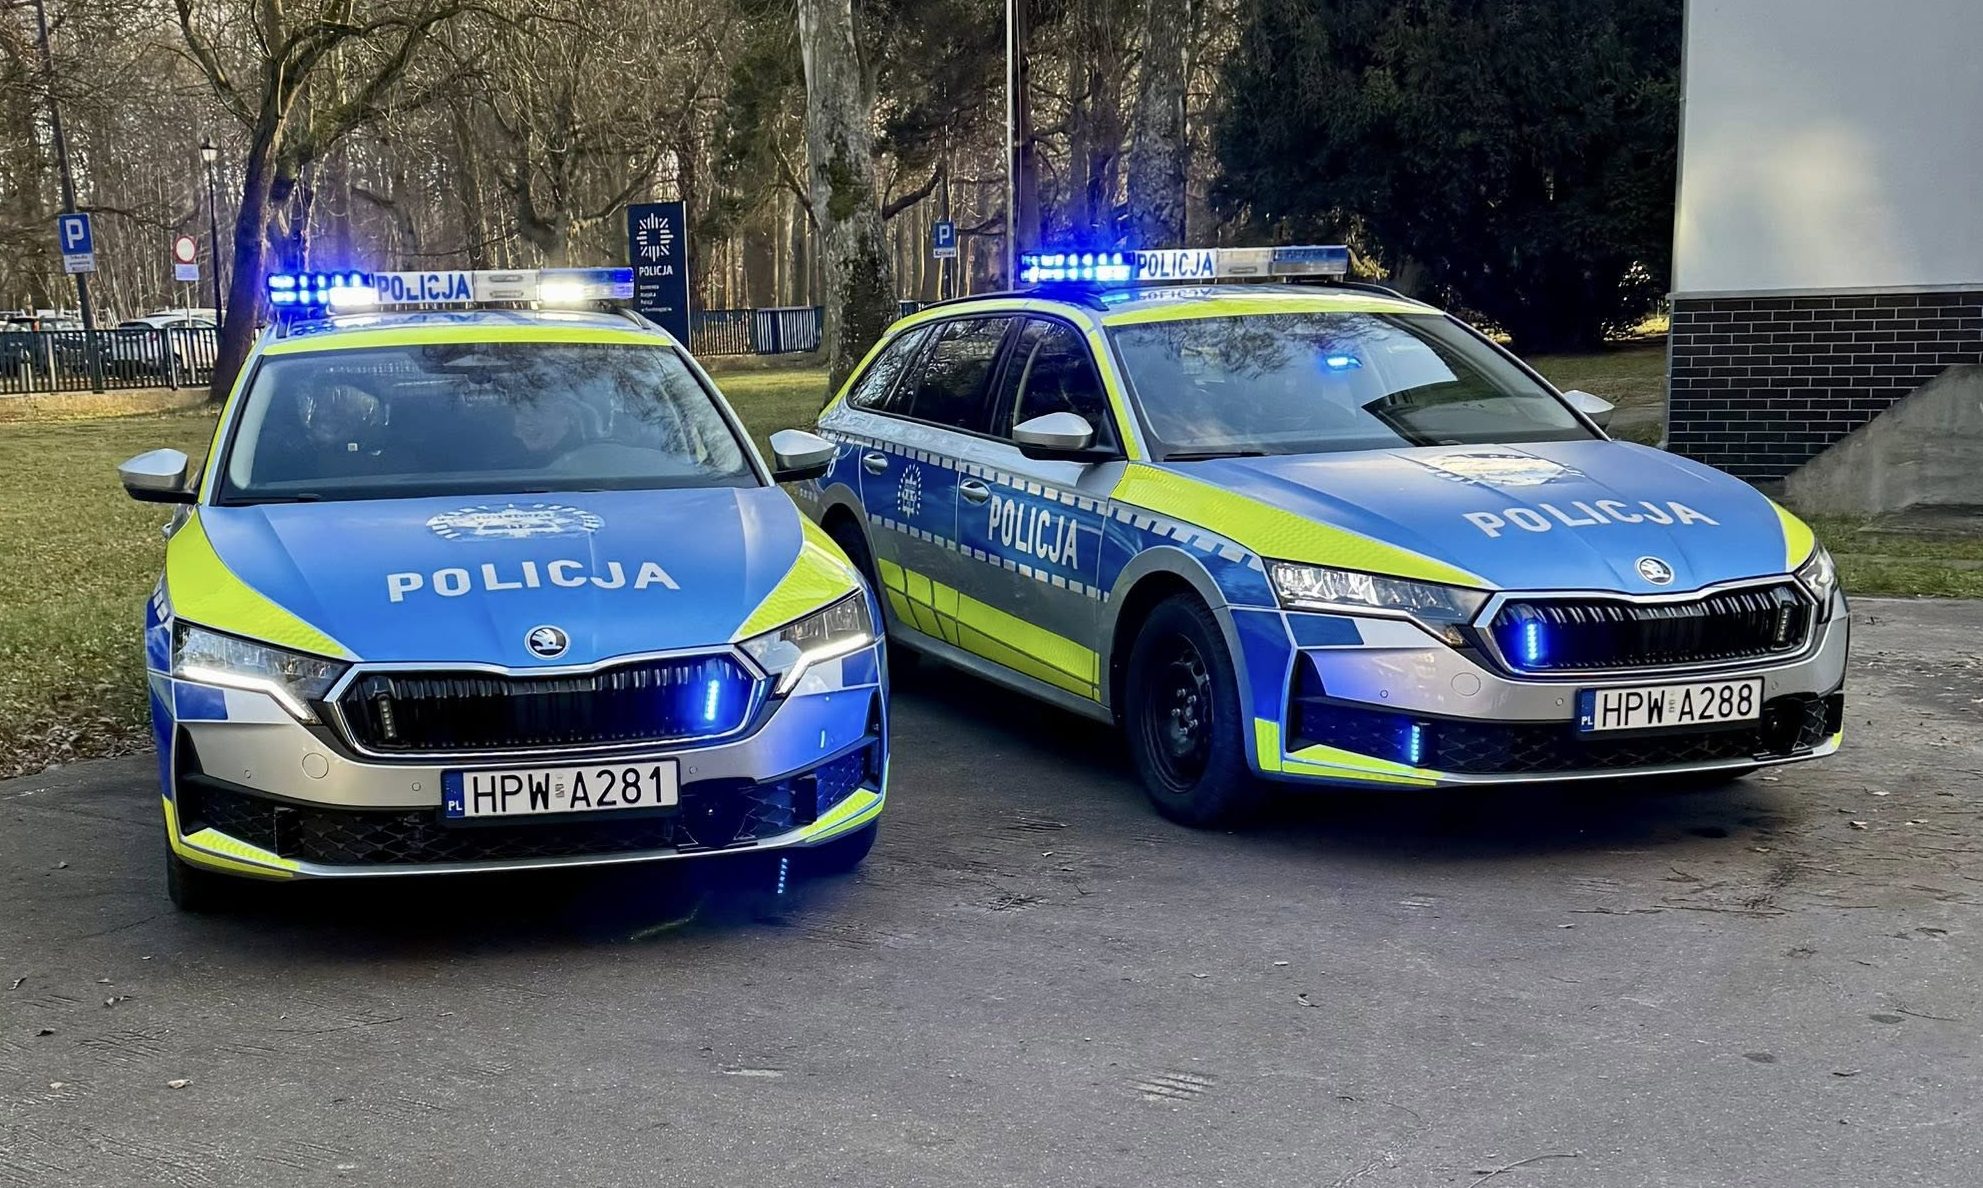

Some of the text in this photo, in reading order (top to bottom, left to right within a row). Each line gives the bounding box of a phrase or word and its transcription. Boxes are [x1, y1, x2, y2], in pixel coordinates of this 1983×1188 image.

[65, 218, 84, 249] P
[939, 225, 950, 245] P
[639, 265, 674, 276] POLICJA
[1135, 252, 1214, 278] POLICJA
[376, 273, 471, 302] POLICJA
[988, 494, 1078, 570] POLICJA
[1463, 499, 1720, 538] POLICJA
[386, 559, 681, 603] POLICJA
[1602, 683, 1752, 727] HPW A288
[1581, 716, 1593, 726] PL
[473, 772, 550, 814] HPW
[569, 766, 662, 809] A281
[448, 800, 463, 811] PL
